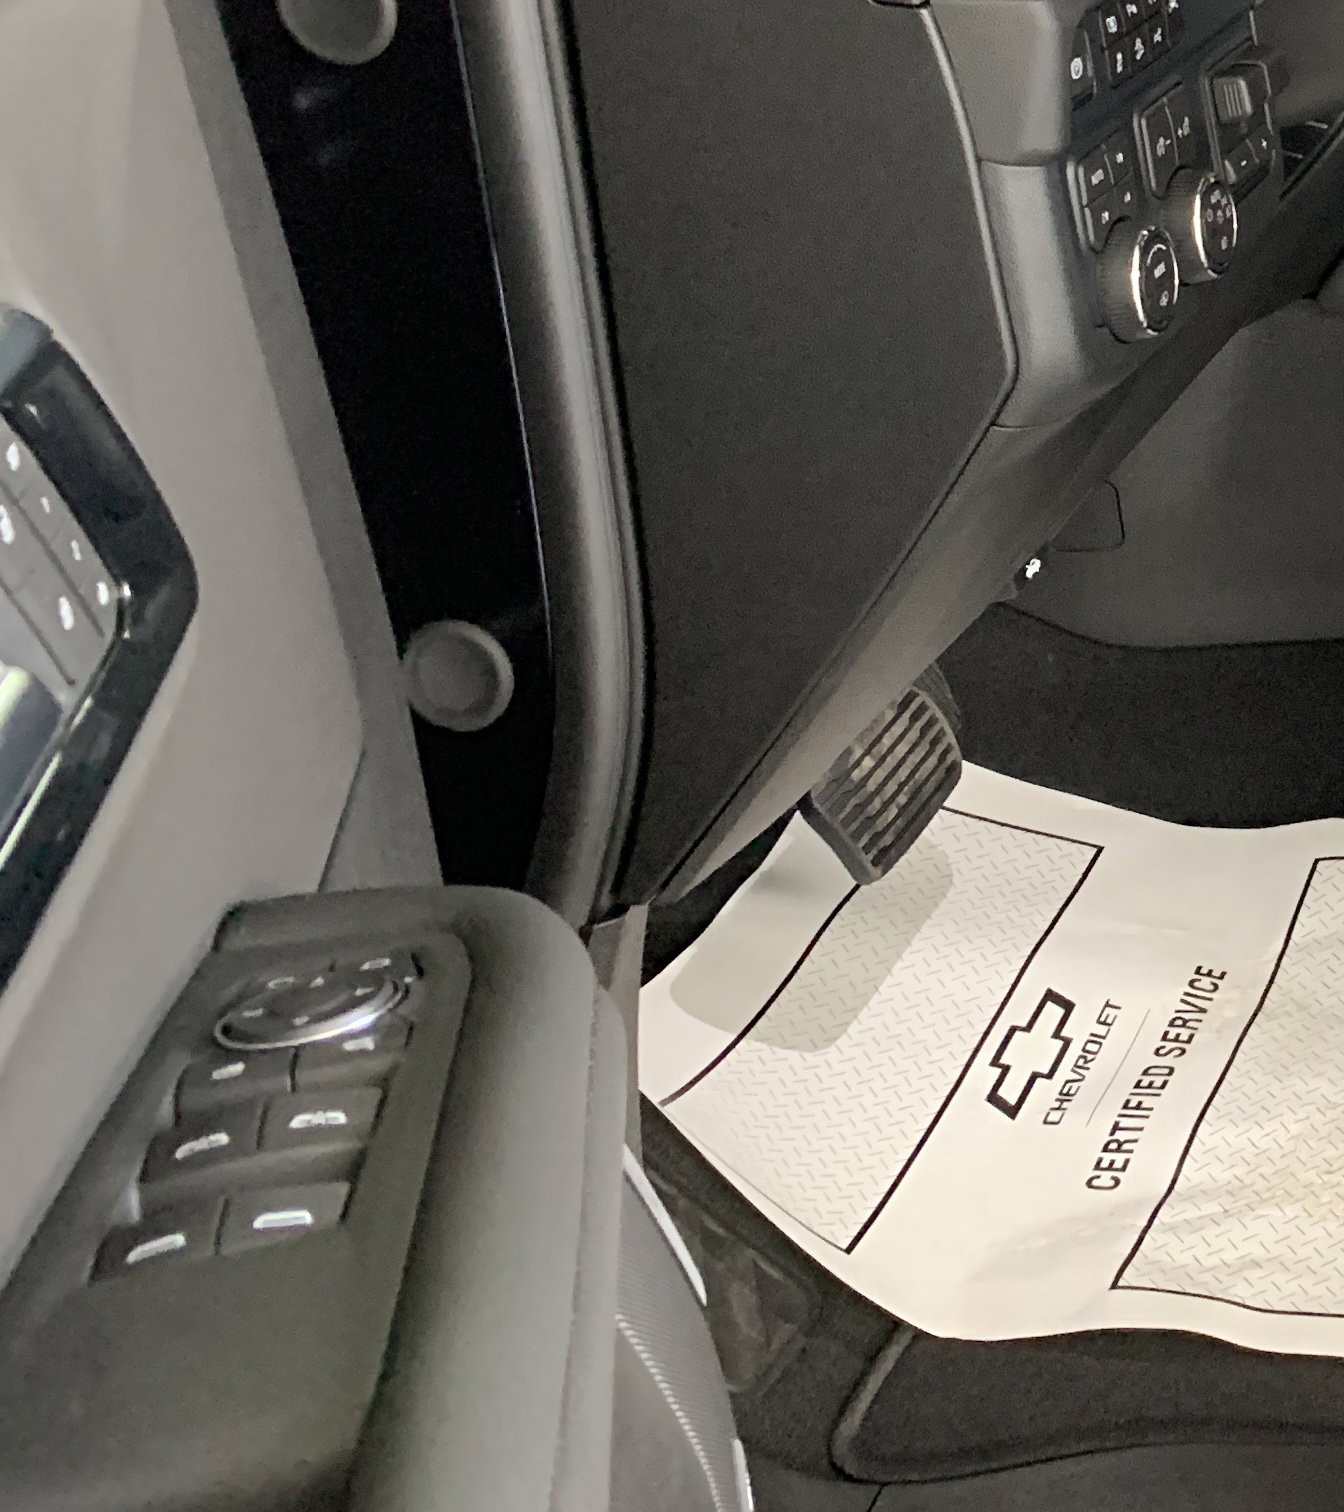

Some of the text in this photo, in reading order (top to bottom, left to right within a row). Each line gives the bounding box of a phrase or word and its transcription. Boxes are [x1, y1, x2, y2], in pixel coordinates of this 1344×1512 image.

[1042, 998, 1122, 1125] CHEVROLET
[1085, 965, 1227, 1191] CERTIFIED SERVICE
